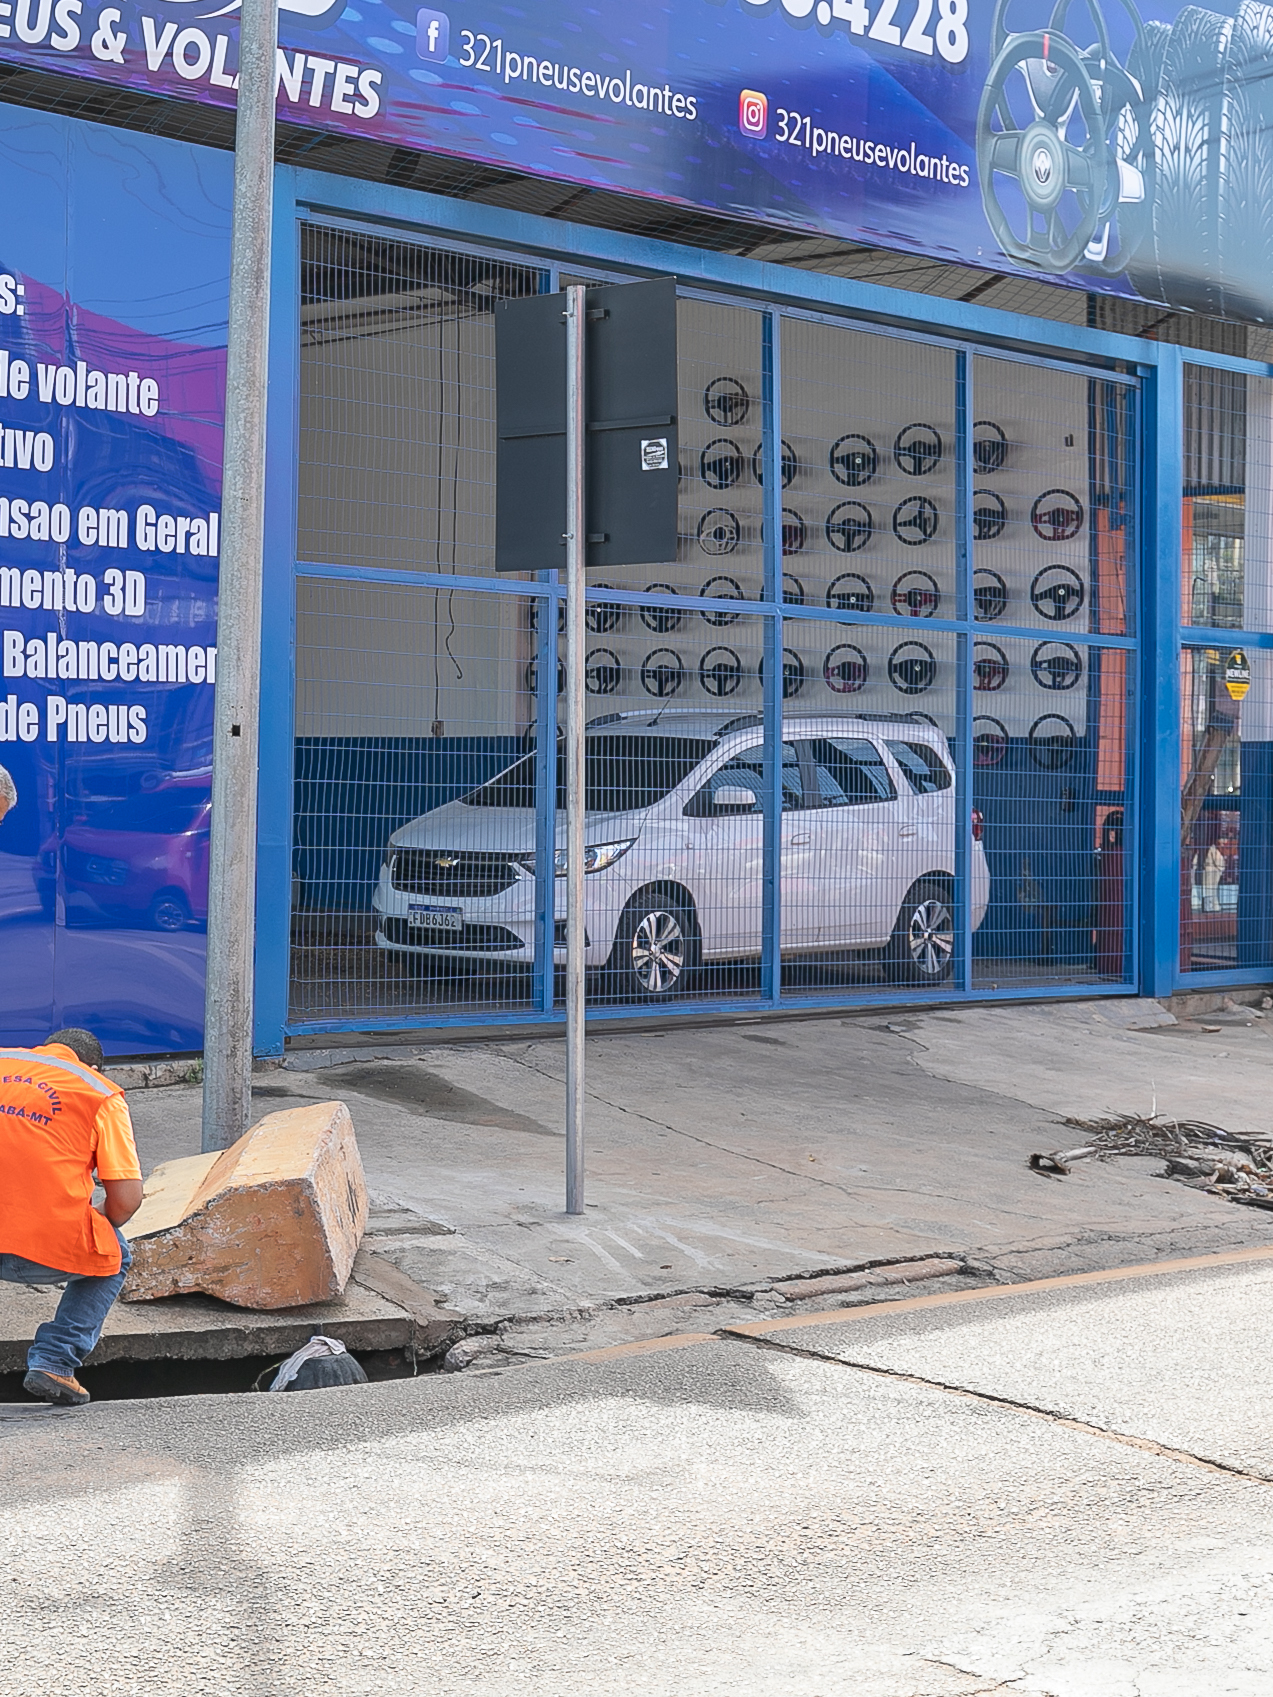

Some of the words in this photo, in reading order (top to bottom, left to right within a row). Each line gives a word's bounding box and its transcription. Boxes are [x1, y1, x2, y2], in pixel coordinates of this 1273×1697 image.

[91, 8, 127, 64] &
[142, 15, 382, 119] VOLNTES
[459, 30, 697, 120] 321pneusevolantes
[775, 108, 970, 187] 321pneusevolantes
[36, 360, 159, 417] volante
[78, 506, 128, 549] em
[135, 504, 218, 557] Geral
[103, 568, 145, 616] 3D
[47, 695, 147, 744] Pneus
[37, 1081, 62, 1115] CIVIL
